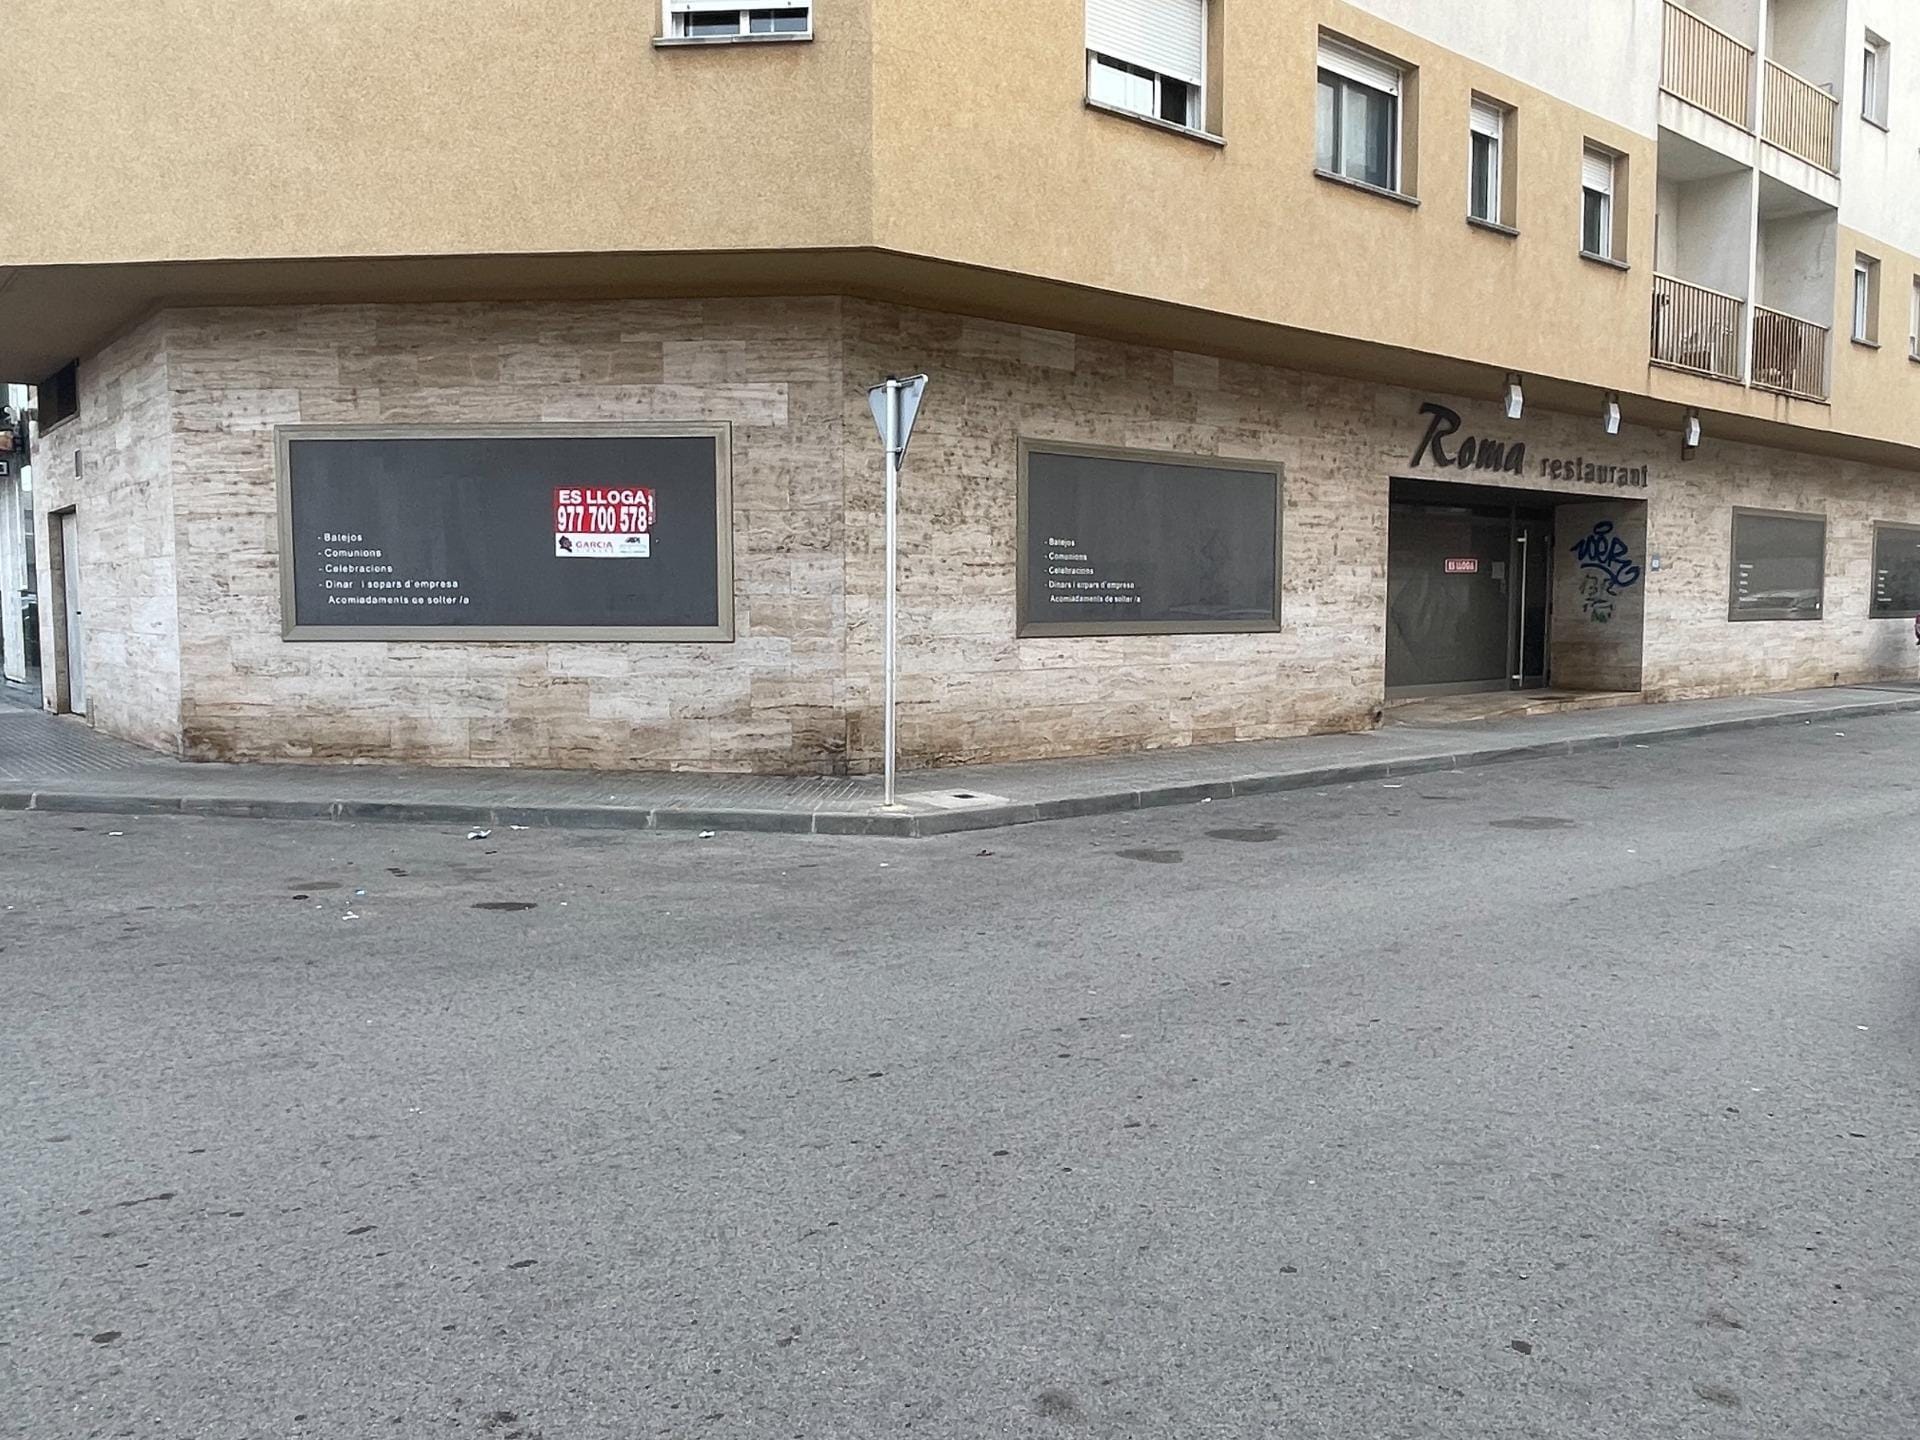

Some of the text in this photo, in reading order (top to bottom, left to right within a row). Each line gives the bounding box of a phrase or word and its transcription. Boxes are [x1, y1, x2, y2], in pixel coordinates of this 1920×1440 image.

[1410, 402, 1649, 488] Roma restaurant
[559, 489, 648, 505] ES LLOGA
[557, 505, 585, 532] 977
[588, 505, 616, 532] 700
[620, 505, 648, 532] 578
[323, 532, 363, 543] Batejos
[575, 541, 613, 549] GARCIA
[324, 548, 382, 558] Comunions
[325, 564, 393, 573] Celebracions
[367, 581, 402, 590] sopars
